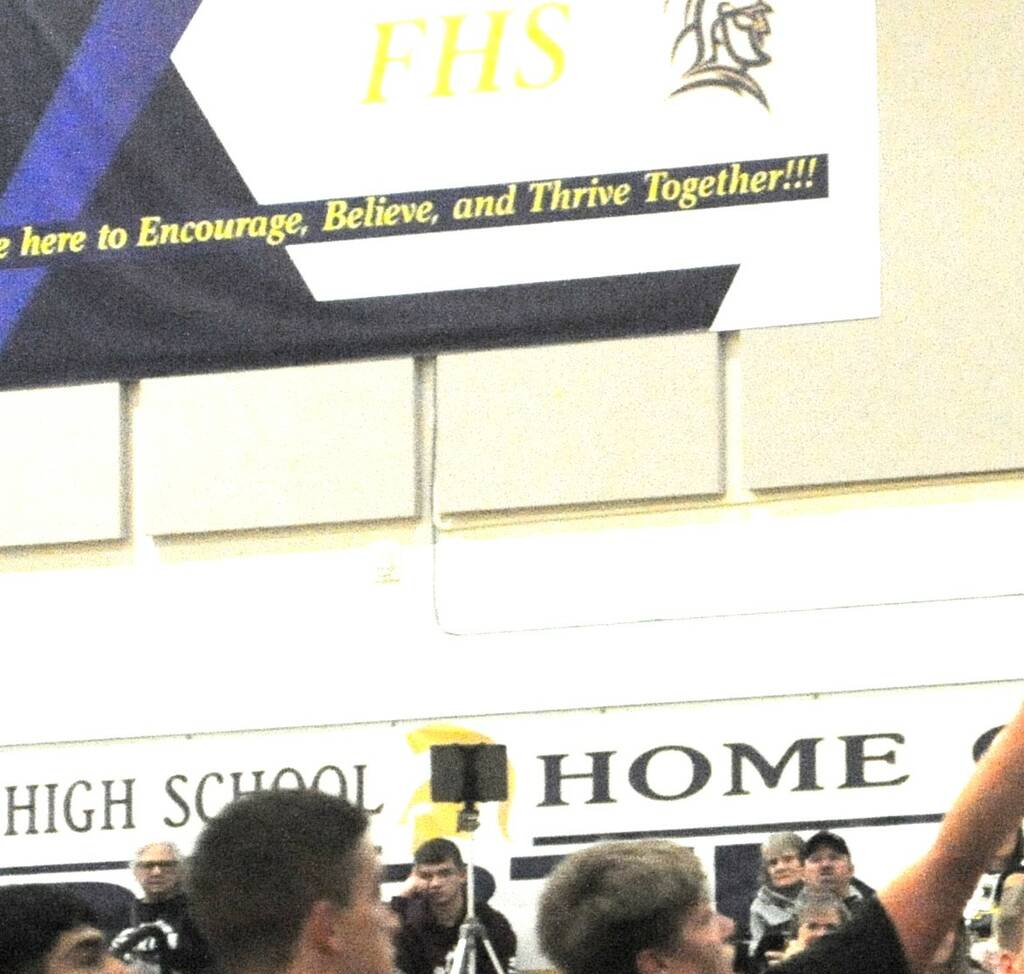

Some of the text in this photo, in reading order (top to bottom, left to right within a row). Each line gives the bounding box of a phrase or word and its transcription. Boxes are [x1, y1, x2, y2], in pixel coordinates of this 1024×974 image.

[359, 3, 571, 105] FHS
[20, 226, 86, 256] here
[97, 224, 128, 250] to
[136, 211, 308, 246] Encourage,
[322, 196, 439, 232] Believe,
[452, 183, 516, 220] and
[529, 177, 632, 214] Thrive
[644, 157, 817, 209] Together!!!
[4, 778, 136, 836] HIGH
[536, 733, 910, 807] HOME
